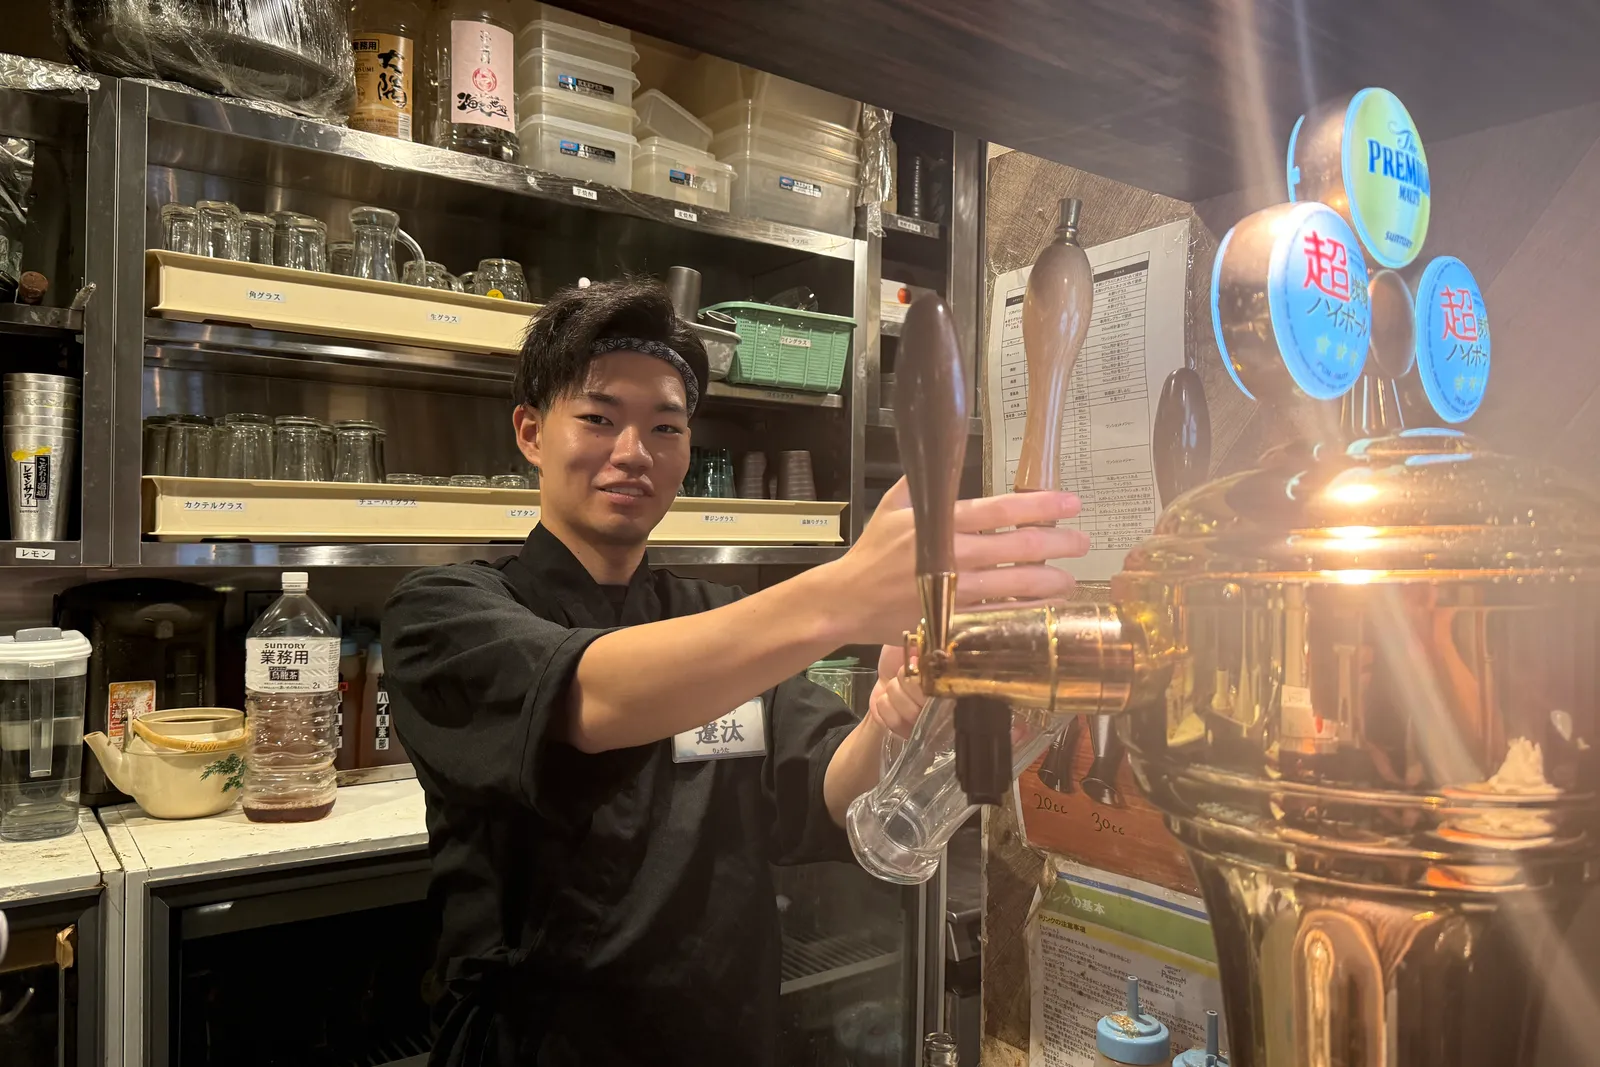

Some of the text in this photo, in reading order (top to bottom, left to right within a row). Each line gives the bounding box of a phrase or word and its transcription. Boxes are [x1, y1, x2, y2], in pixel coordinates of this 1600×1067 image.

[1303, 230, 1351, 302] 超
[248, 290, 281, 301] 角グラス
[430, 313, 458, 323] 生グラス
[1440, 285, 1478, 341] 超
[781, 336, 808, 346] ワイングラス
[23, 464, 34, 505] レモンサワー
[184, 500, 243, 510] カクテルグラス
[359, 498, 417, 506] チューハイグラス
[510, 509, 536, 517] ビアタン
[22, 549, 50, 558] レモン
[260, 649, 309, 665] 業務用
[271, 670, 298, 680] 烏龍茶
[1034, 793, 1067, 814] 20cc
[1092, 812, 1125, 835] 30cc
